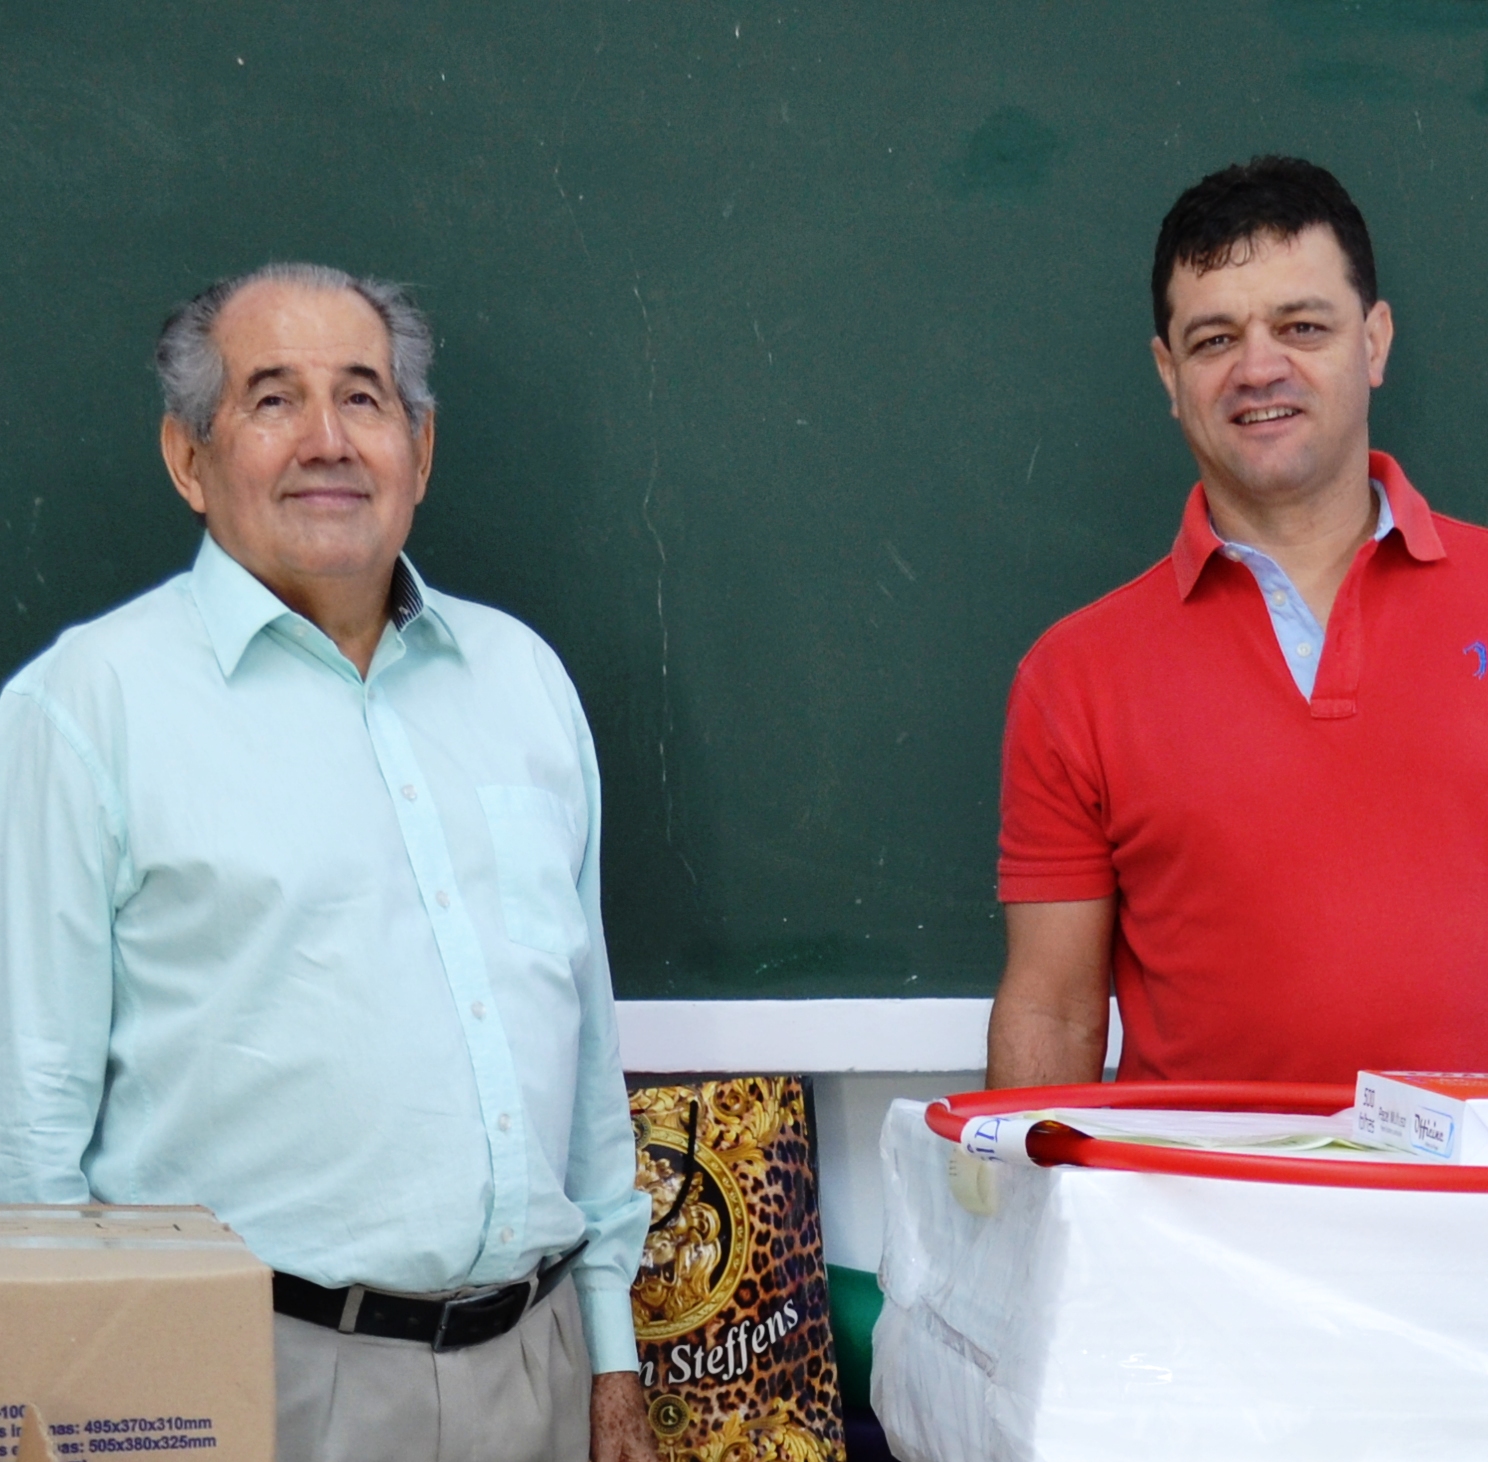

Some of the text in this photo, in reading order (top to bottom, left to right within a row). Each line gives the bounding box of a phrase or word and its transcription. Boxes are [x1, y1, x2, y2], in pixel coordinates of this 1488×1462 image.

[668, 1299, 799, 1386] Steffens
[84, 1417, 213, 1434] 495x370x310mm
[89, 1435, 217, 1453] 505x380x325mm
